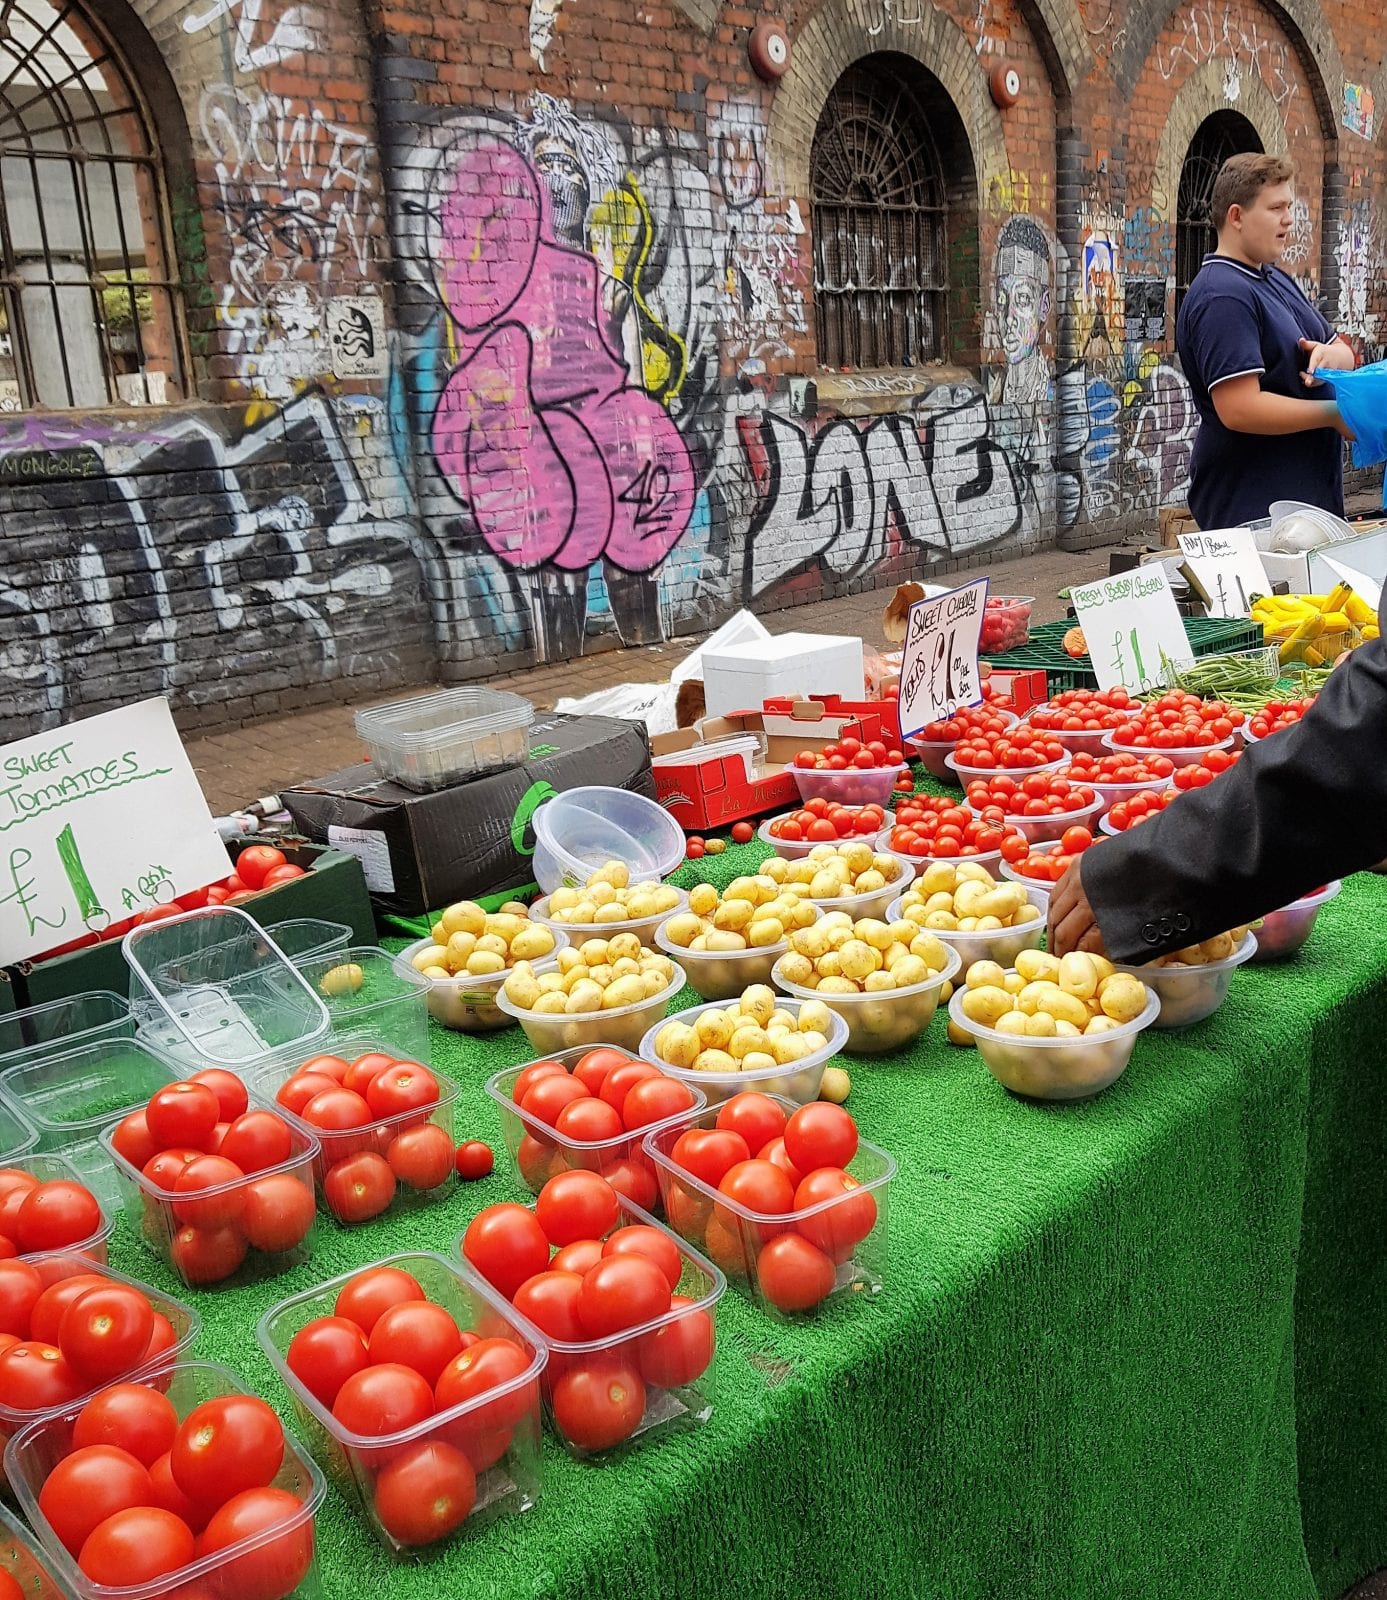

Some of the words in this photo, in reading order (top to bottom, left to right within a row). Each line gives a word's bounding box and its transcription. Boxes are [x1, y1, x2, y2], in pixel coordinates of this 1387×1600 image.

[1183, 536, 1205, 555] ANY
[947, 588, 978, 617] CHERRY
[1075, 588, 1103, 604] FRESH
[1104, 577, 1133, 600] BOBBY
[1135, 576, 1163, 596] BEAN
[4, 742, 74, 780] SWEET
[0, 751, 139, 813] TOMATOES
